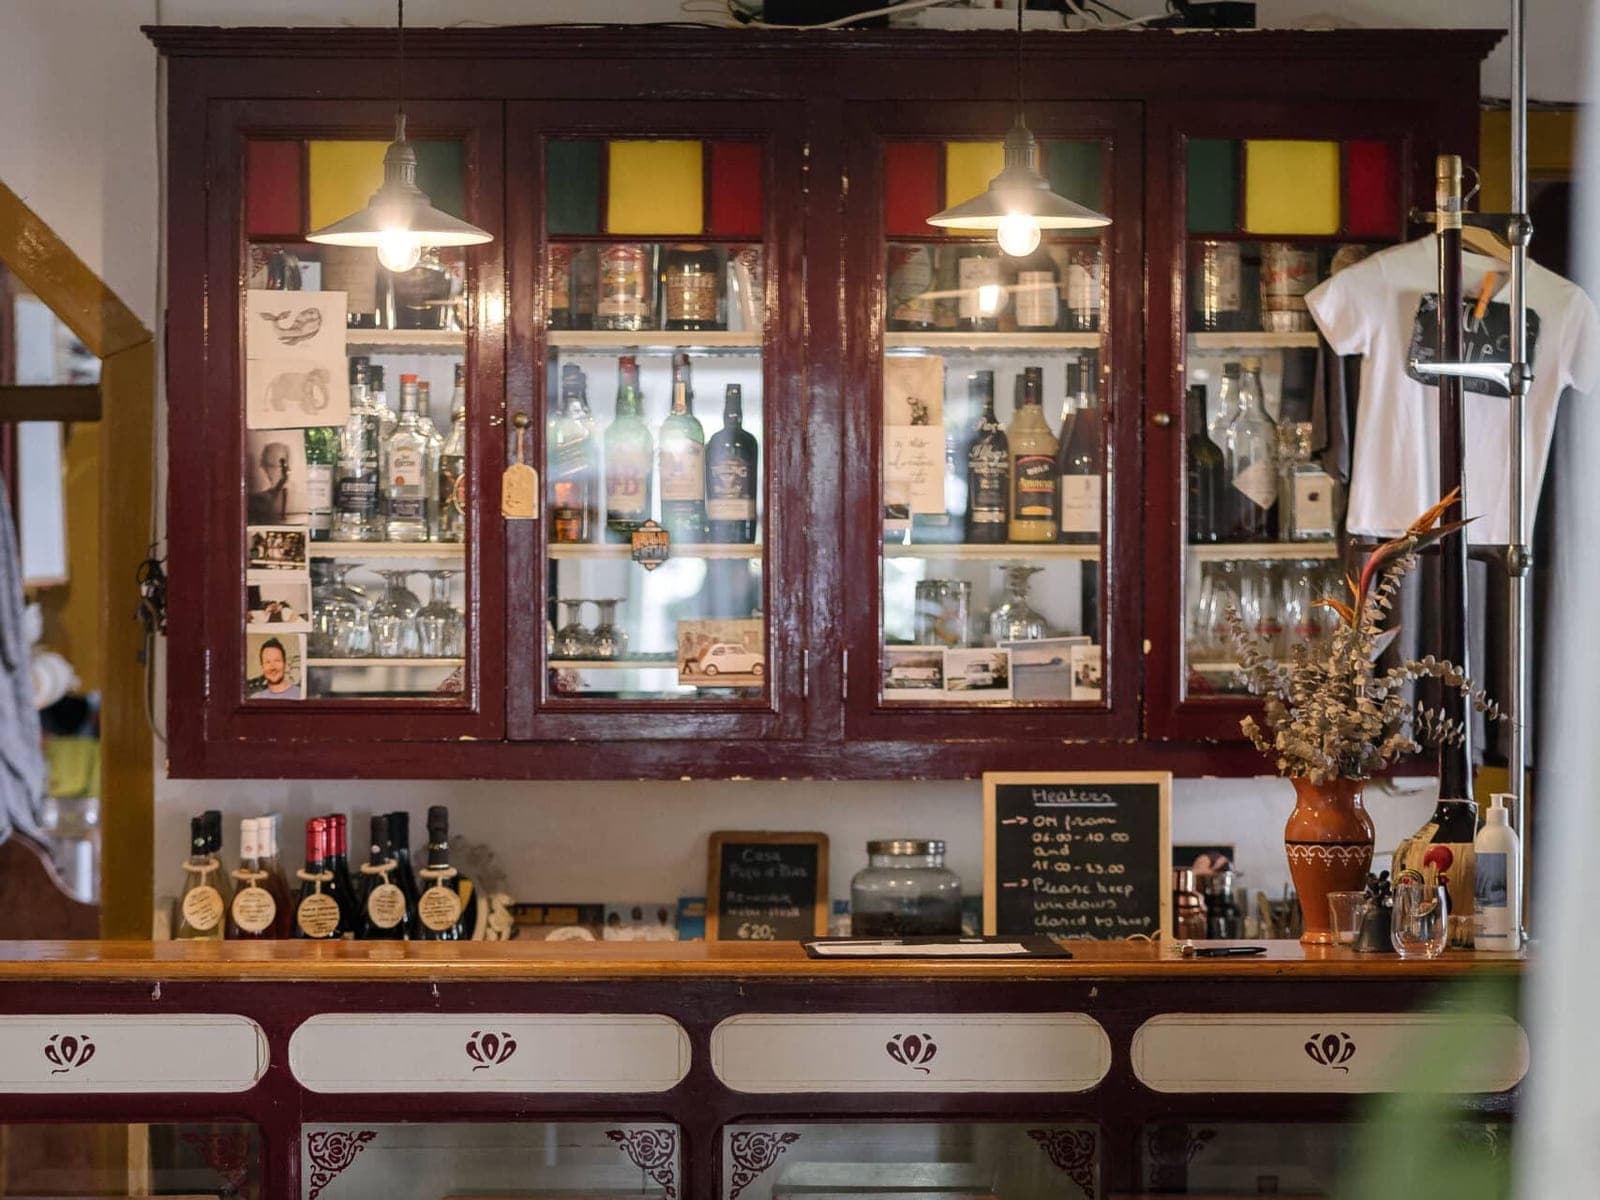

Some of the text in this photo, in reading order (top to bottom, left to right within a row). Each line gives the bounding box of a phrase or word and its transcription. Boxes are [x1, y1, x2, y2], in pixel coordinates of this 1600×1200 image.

[1032, 788, 1112, 803] Heaters
[1033, 843, 1070, 857] and
[1032, 877, 1134, 898] Please keep
[1033, 899, 1118, 911] windows
[1034, 915, 1087, 926] closed
[1094, 916, 1114, 927] to
